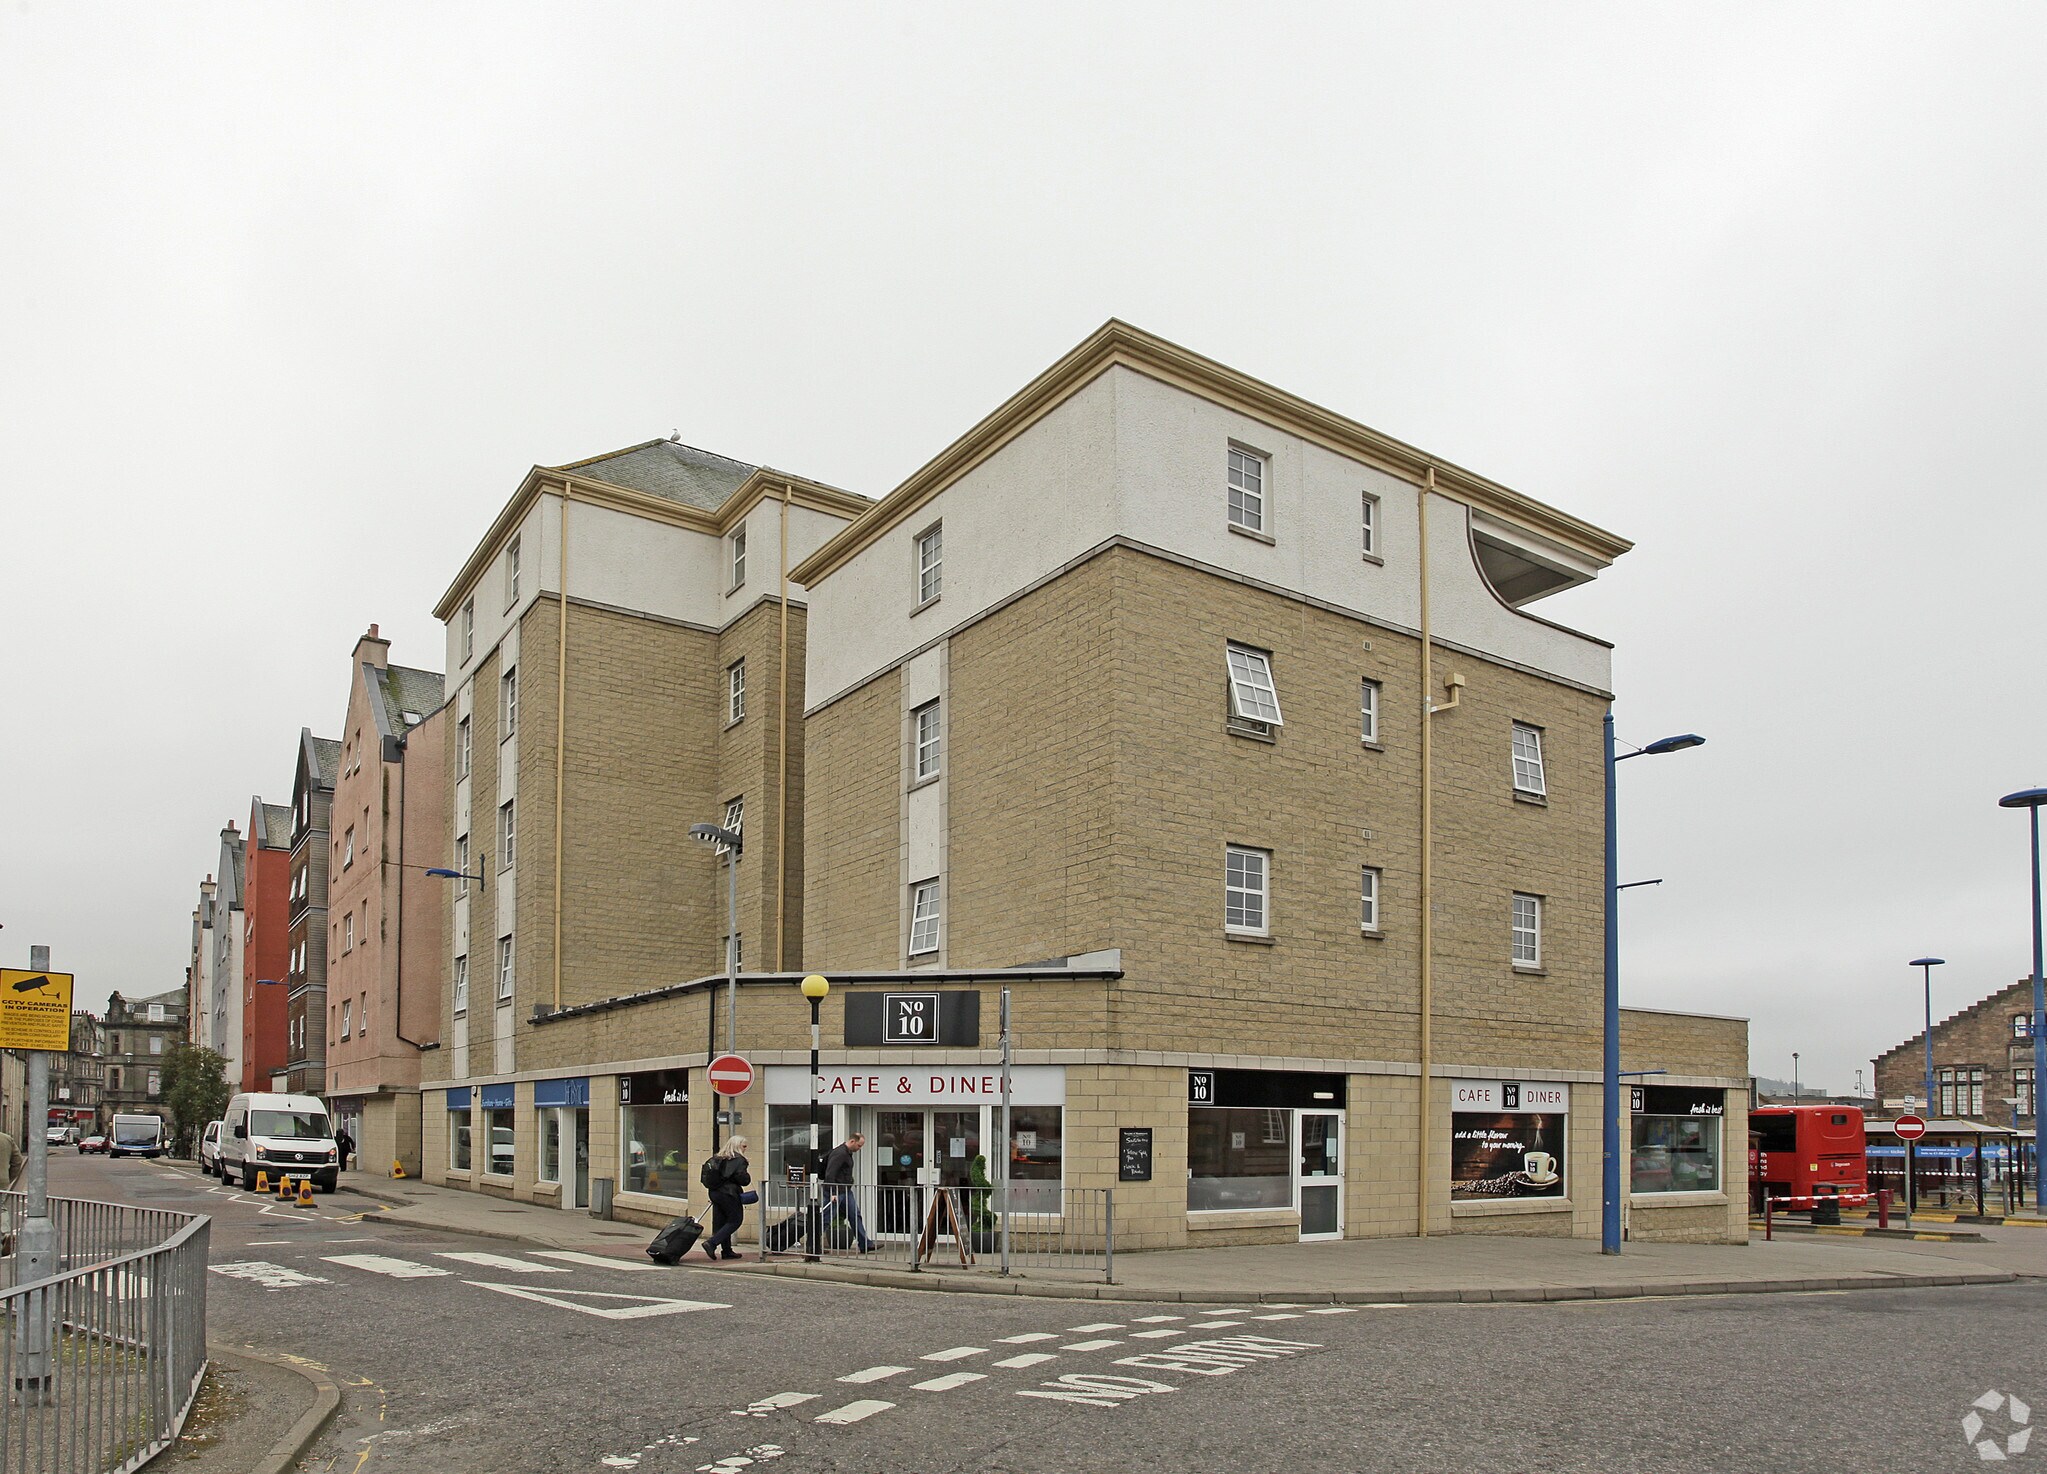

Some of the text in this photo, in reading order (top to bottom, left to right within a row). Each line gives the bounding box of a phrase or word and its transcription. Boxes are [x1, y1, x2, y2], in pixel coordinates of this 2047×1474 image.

[899, 1016, 924, 1035] 10
[817, 1076, 880, 1094] CAFE
[896, 1076, 912, 1094] &
[623, 1089, 628, 1100] 10
[663, 1089, 677, 1104] fresh
[1194, 1086, 1207, 1099] 10
[1459, 1089, 1490, 1102] CAFE
[1528, 1091, 1561, 1103] DINER
[1507, 1095, 1515, 1106] 10
[1632, 1099, 1640, 1109] 10
[1690, 1103, 1723, 1115] fresh is best
[1455, 1131, 1466, 1139] add
[1472, 1130, 1487, 1139] little
[1488, 1130, 1508, 1140] flavour
[1489, 1142, 1502, 1152] your
[1015, 1335, 1324, 1407] NO ENTRY
